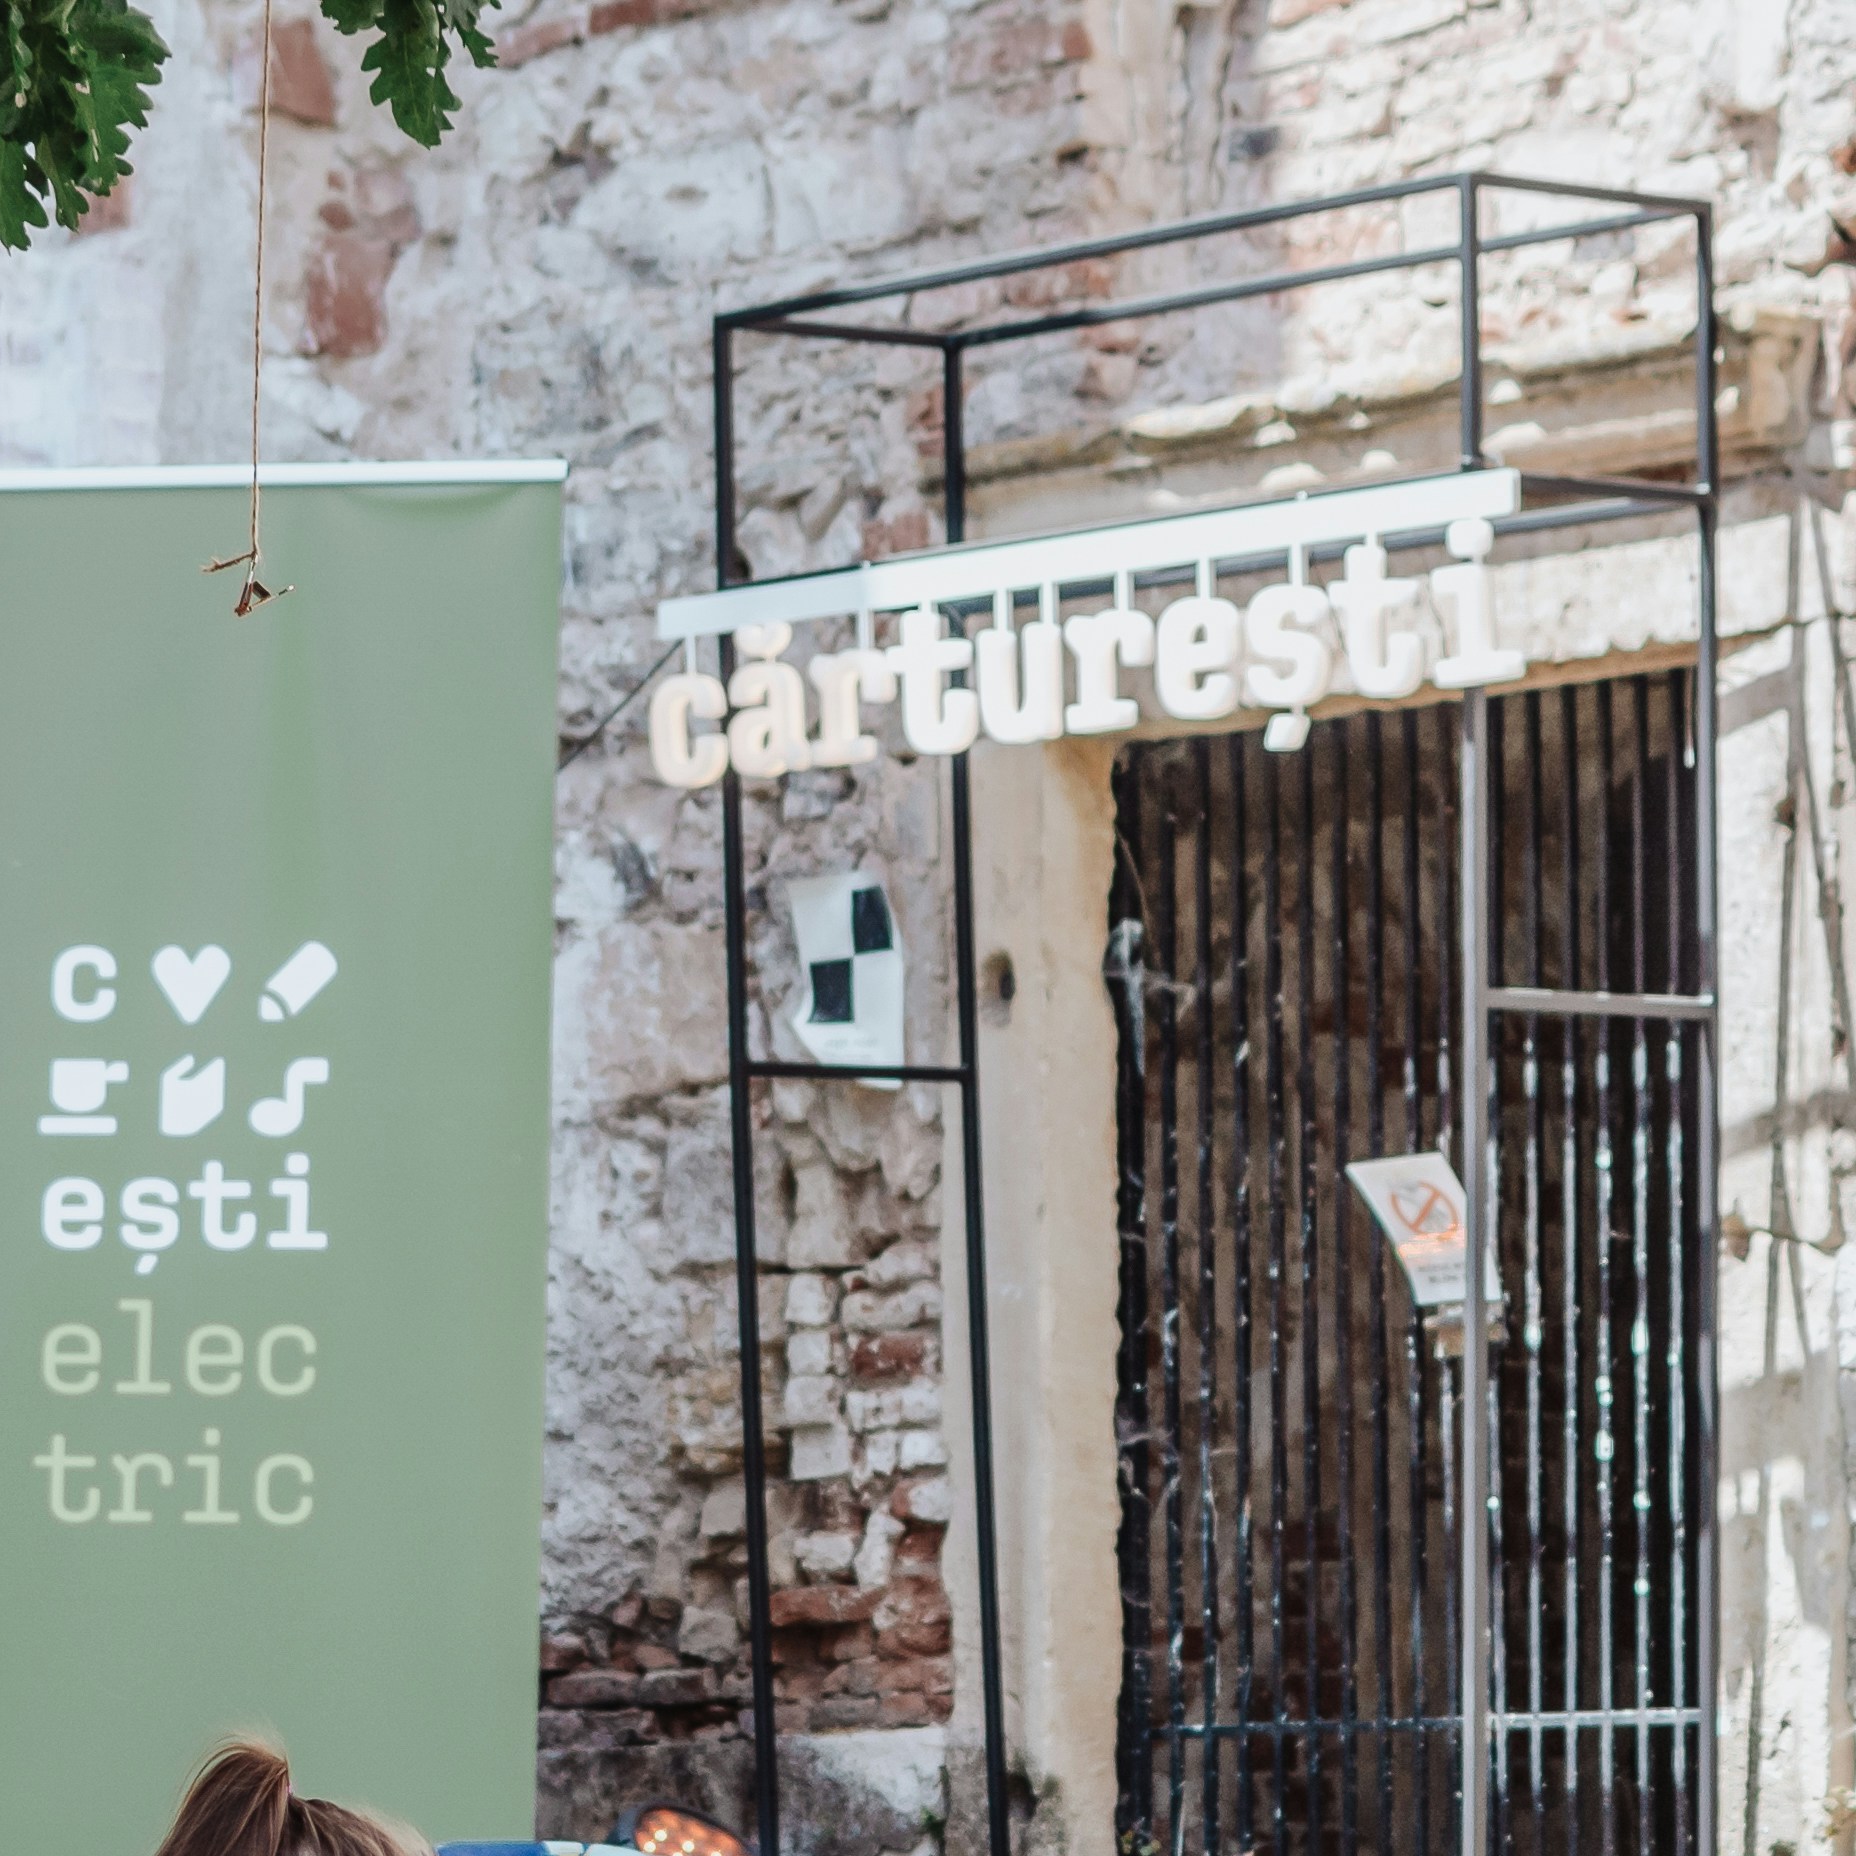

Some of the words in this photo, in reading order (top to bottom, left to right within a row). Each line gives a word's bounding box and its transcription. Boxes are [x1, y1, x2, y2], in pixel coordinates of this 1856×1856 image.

[648, 516, 1528, 789] cărturești
[40, 1152, 329, 1275] ești
[40, 1298, 318, 1395] elec
[32, 1427, 315, 1525] tric
